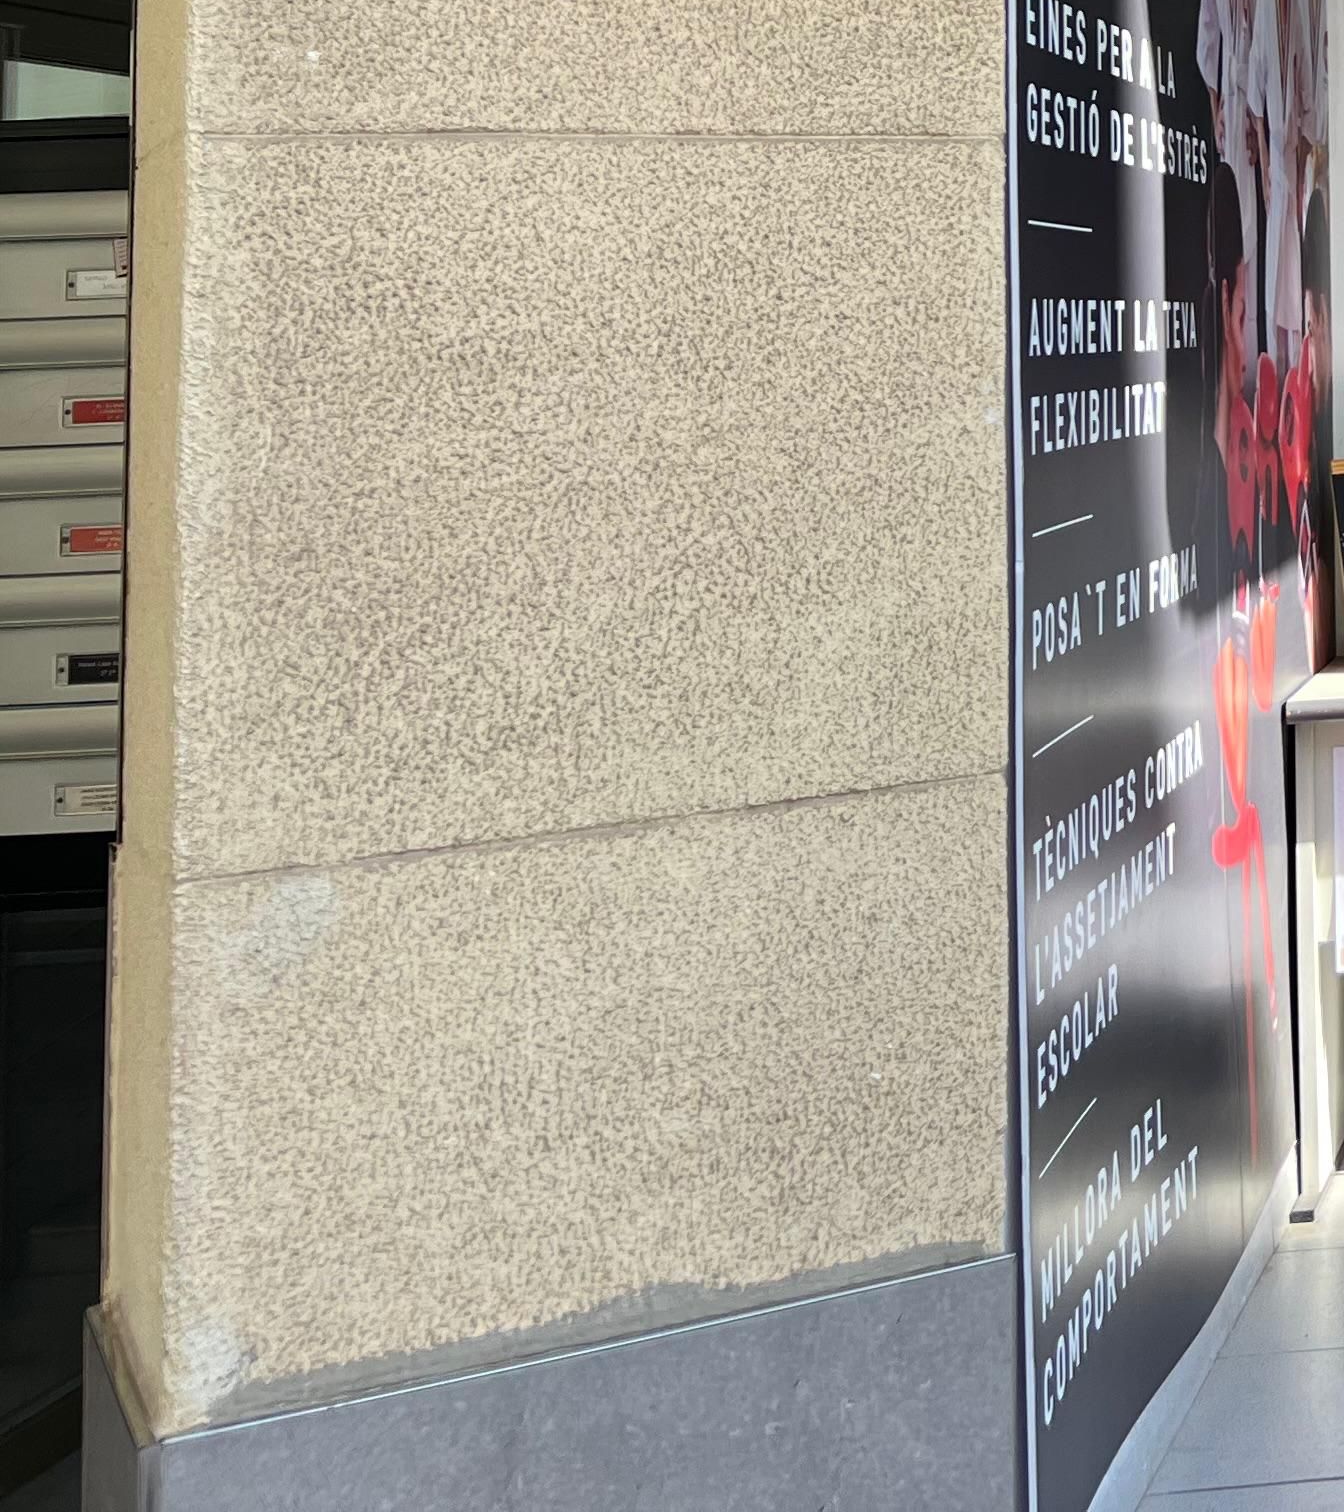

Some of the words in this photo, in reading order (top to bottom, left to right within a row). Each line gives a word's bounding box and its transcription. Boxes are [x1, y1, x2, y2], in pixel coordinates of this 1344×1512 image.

[1097, 18, 1133, 83] PER
[1156, 45, 1175, 99] LA
[1026, 83, 1100, 157] GESTIÓ
[1110, 107, 1134, 166] DE
[1141, 117, 1207, 184] L'ESTRÈS
[1029, 298, 1125, 357] AUGMENT
[1134, 299, 1158, 352] LA
[1163, 302, 1197, 349] TEVA
[1031, 381, 1165, 455] FLEXIBILITAT
[1116, 567, 1140, 628] EN
[1149, 543, 1197, 613] FORMA
[1033, 766, 1137, 901] TÈCNIQUES
[1144, 719, 1203, 813] CONTRA
[1034, 822, 1177, 1006] L'ASSETJAMENT
[1037, 962, 1119, 1109] ESCOLAR
[1040, 1148, 1122, 1323] MILLORA
[1129, 1098, 1169, 1181] DEL
[1043, 1145, 1199, 1427] COMPORTAMENT
